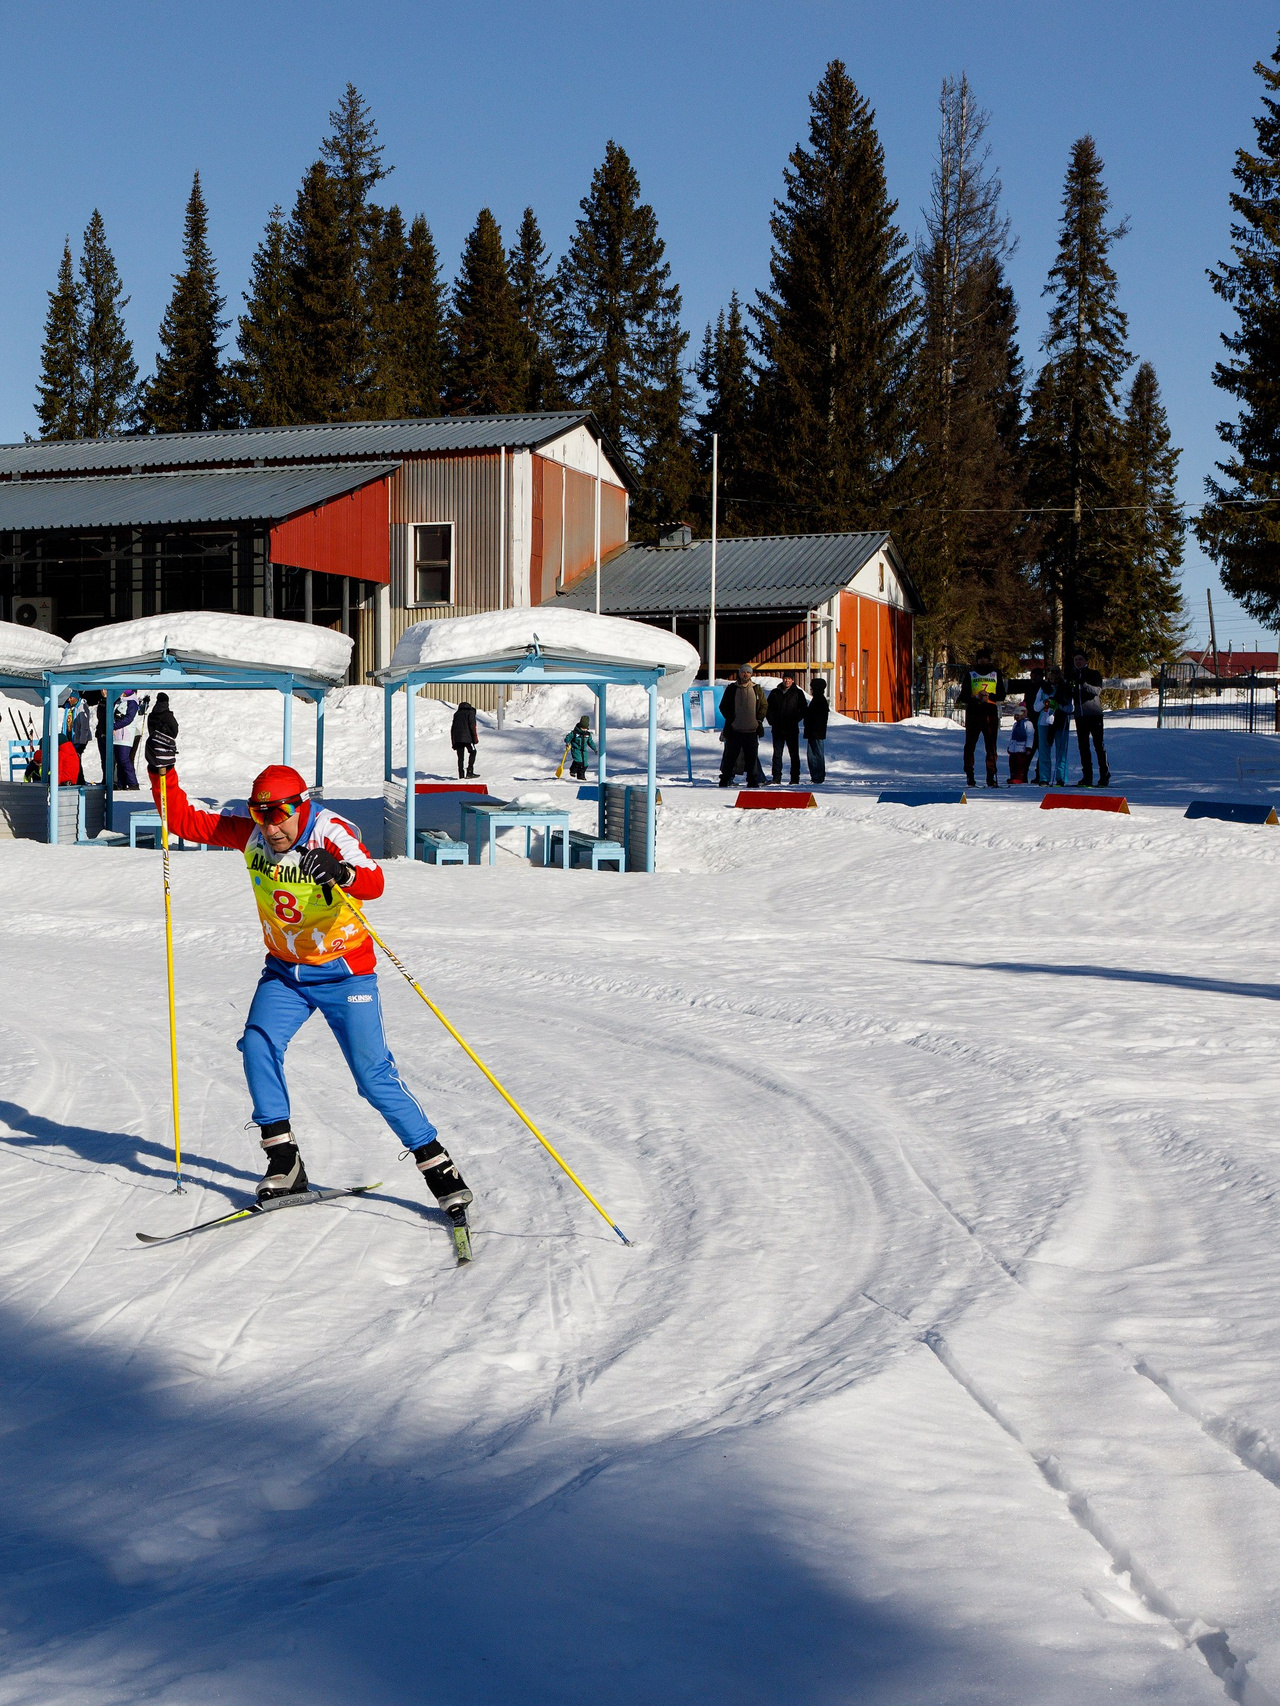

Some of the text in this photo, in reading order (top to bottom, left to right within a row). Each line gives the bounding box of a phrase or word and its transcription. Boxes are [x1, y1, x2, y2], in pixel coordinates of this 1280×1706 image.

[981, 683, 989, 691] 7
[272, 889, 303, 925] 8
[331, 938, 346, 953] 2
